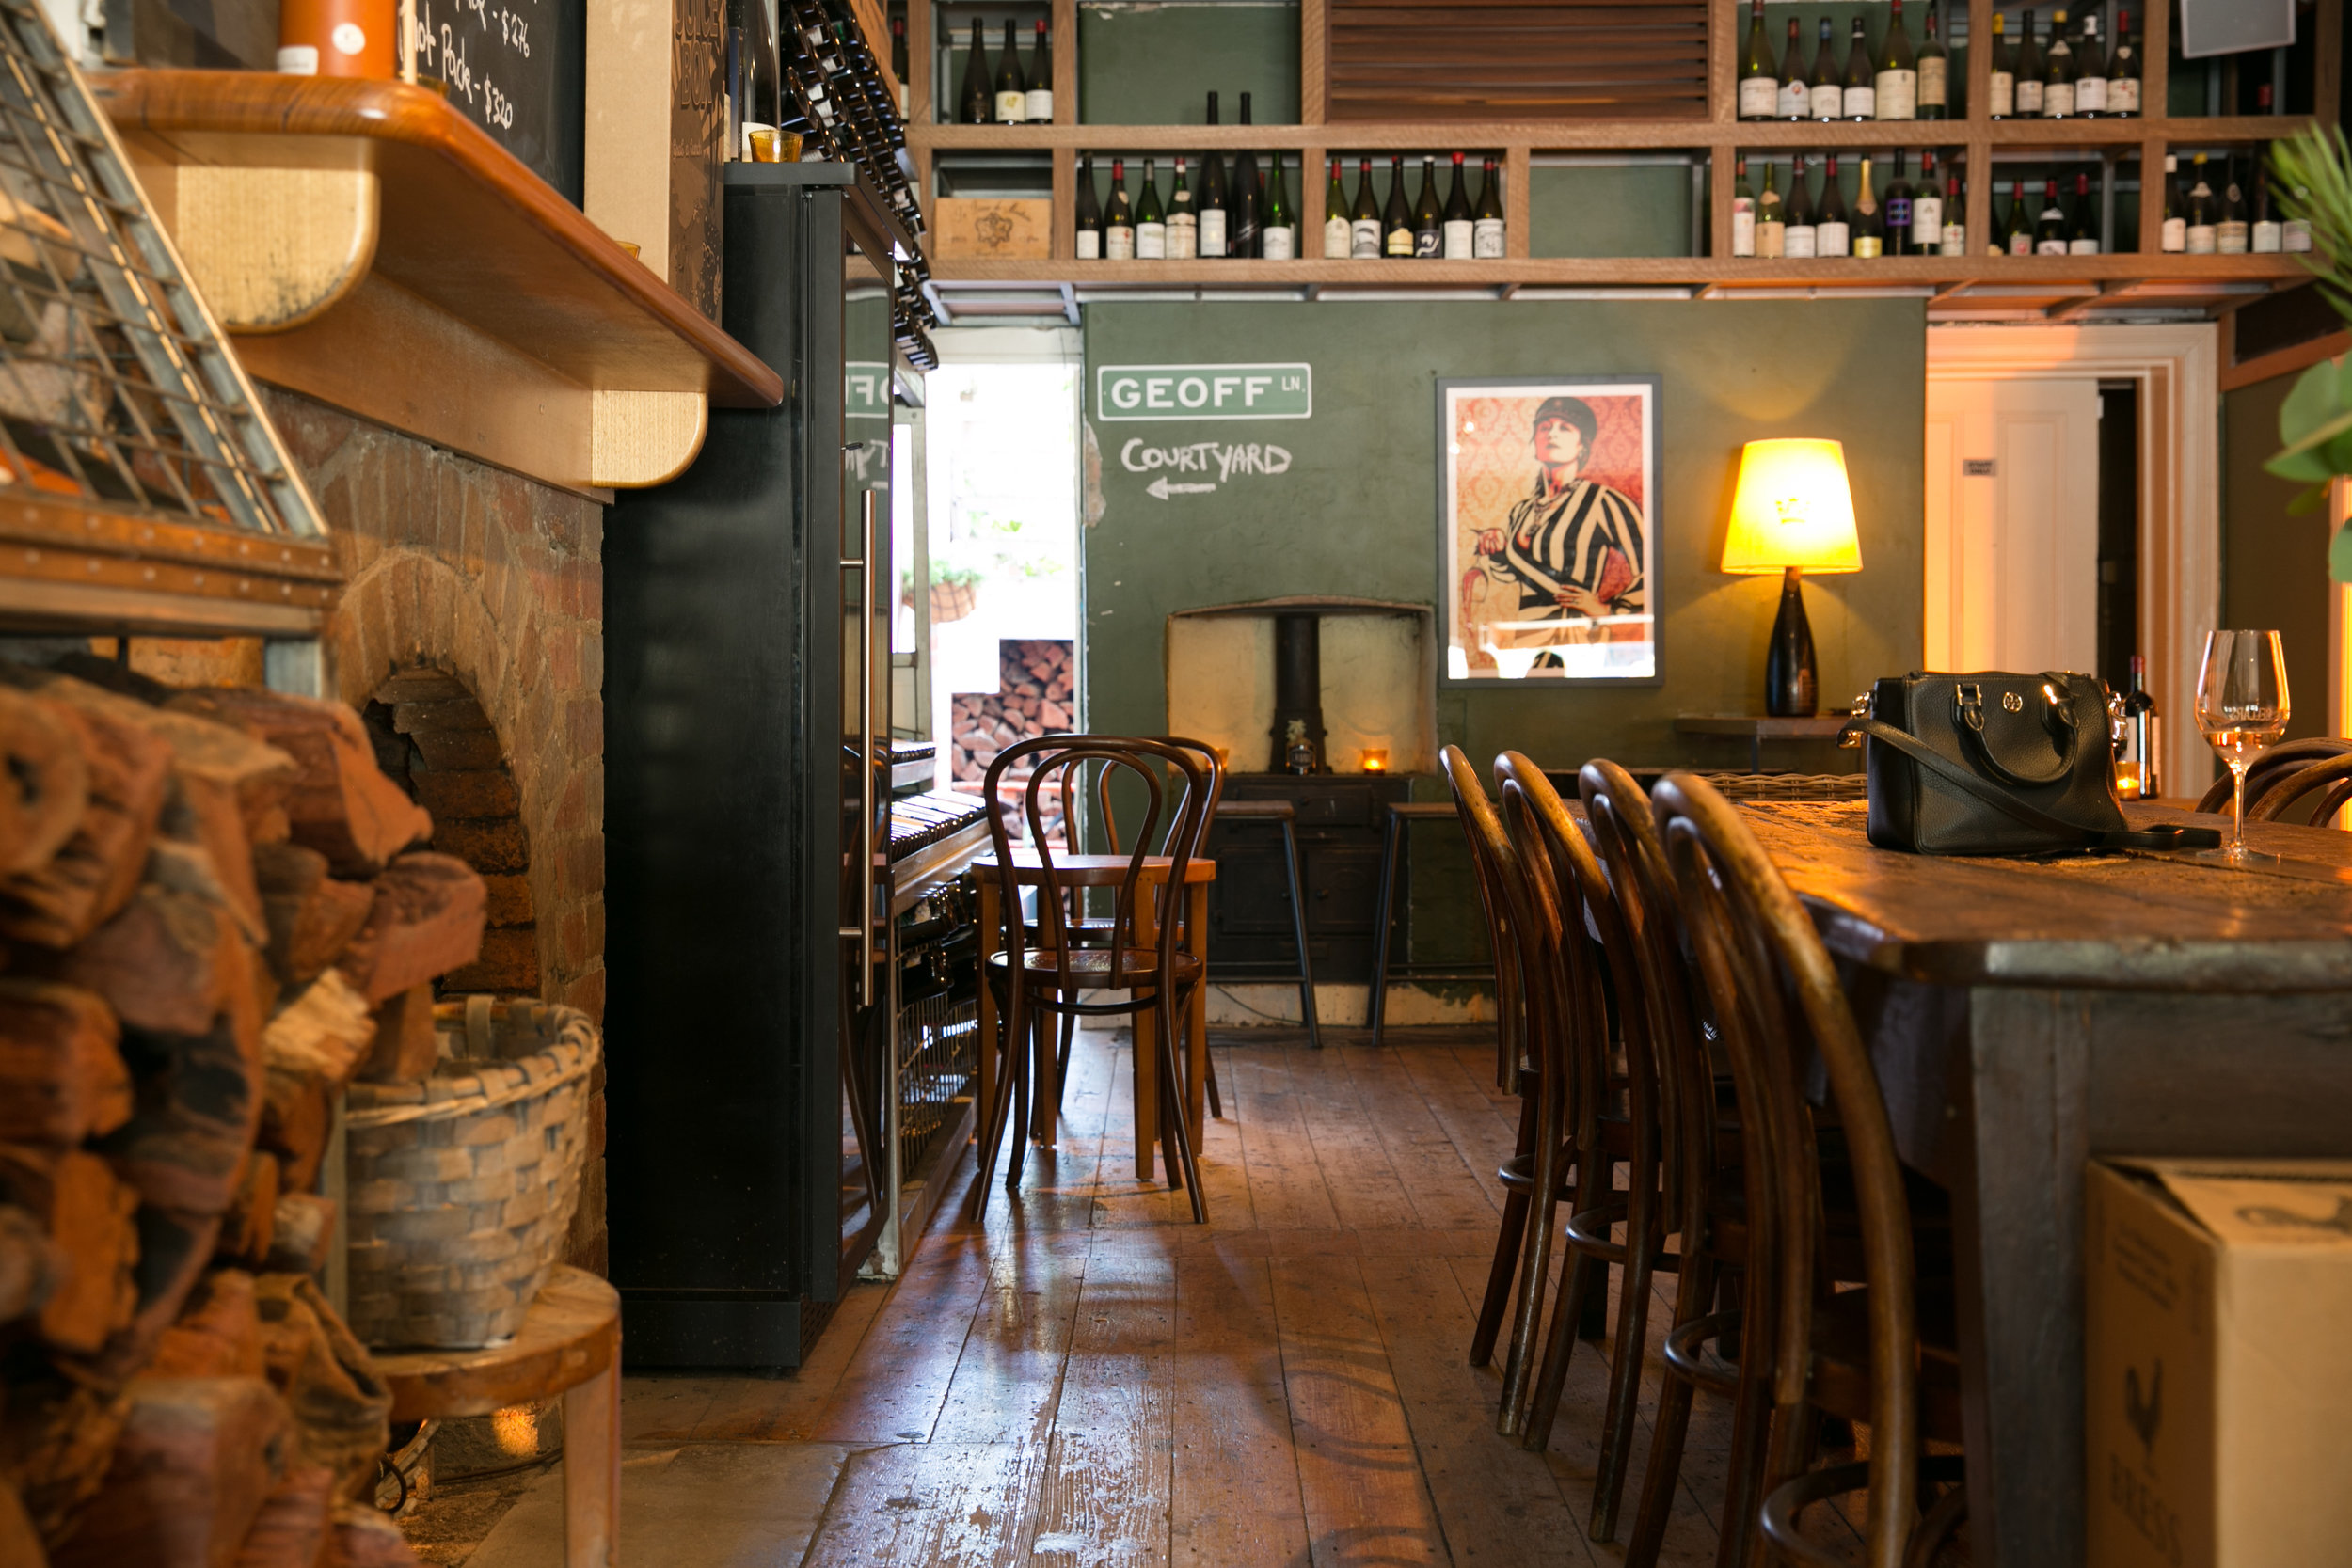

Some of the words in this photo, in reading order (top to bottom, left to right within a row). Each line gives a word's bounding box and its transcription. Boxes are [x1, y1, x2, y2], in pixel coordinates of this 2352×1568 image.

[681, 40, 713, 105] BOX
[485, 72, 513, 130] $320
[1111, 376, 1273, 409] GEOFF
[1281, 376, 1301, 391] LN
[1120, 437, 1293, 483] COURTYARD
